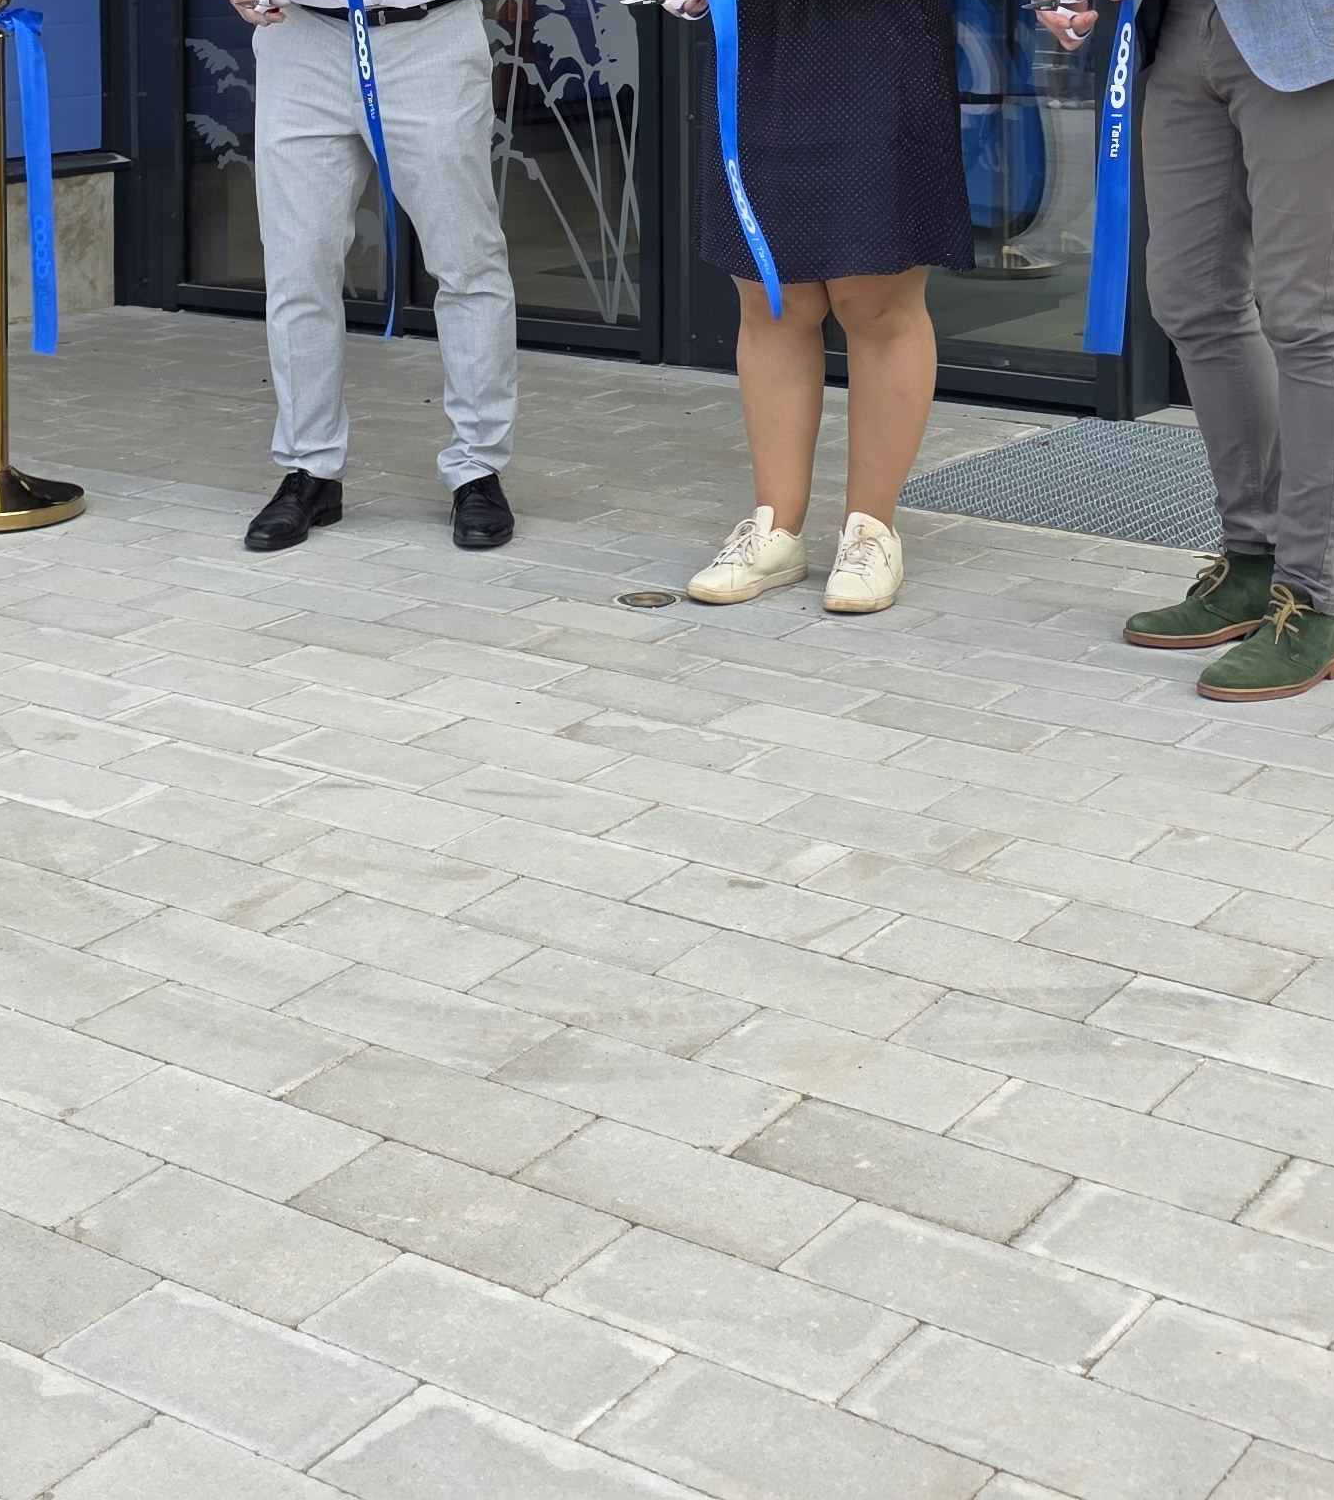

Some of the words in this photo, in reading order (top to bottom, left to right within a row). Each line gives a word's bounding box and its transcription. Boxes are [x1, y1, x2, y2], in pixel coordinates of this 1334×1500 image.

[354, 9, 371, 80] coop
[1110, 22, 1131, 109] coop
[1109, 122, 1122, 158] Tartu
[728, 159, 756, 235] coop
